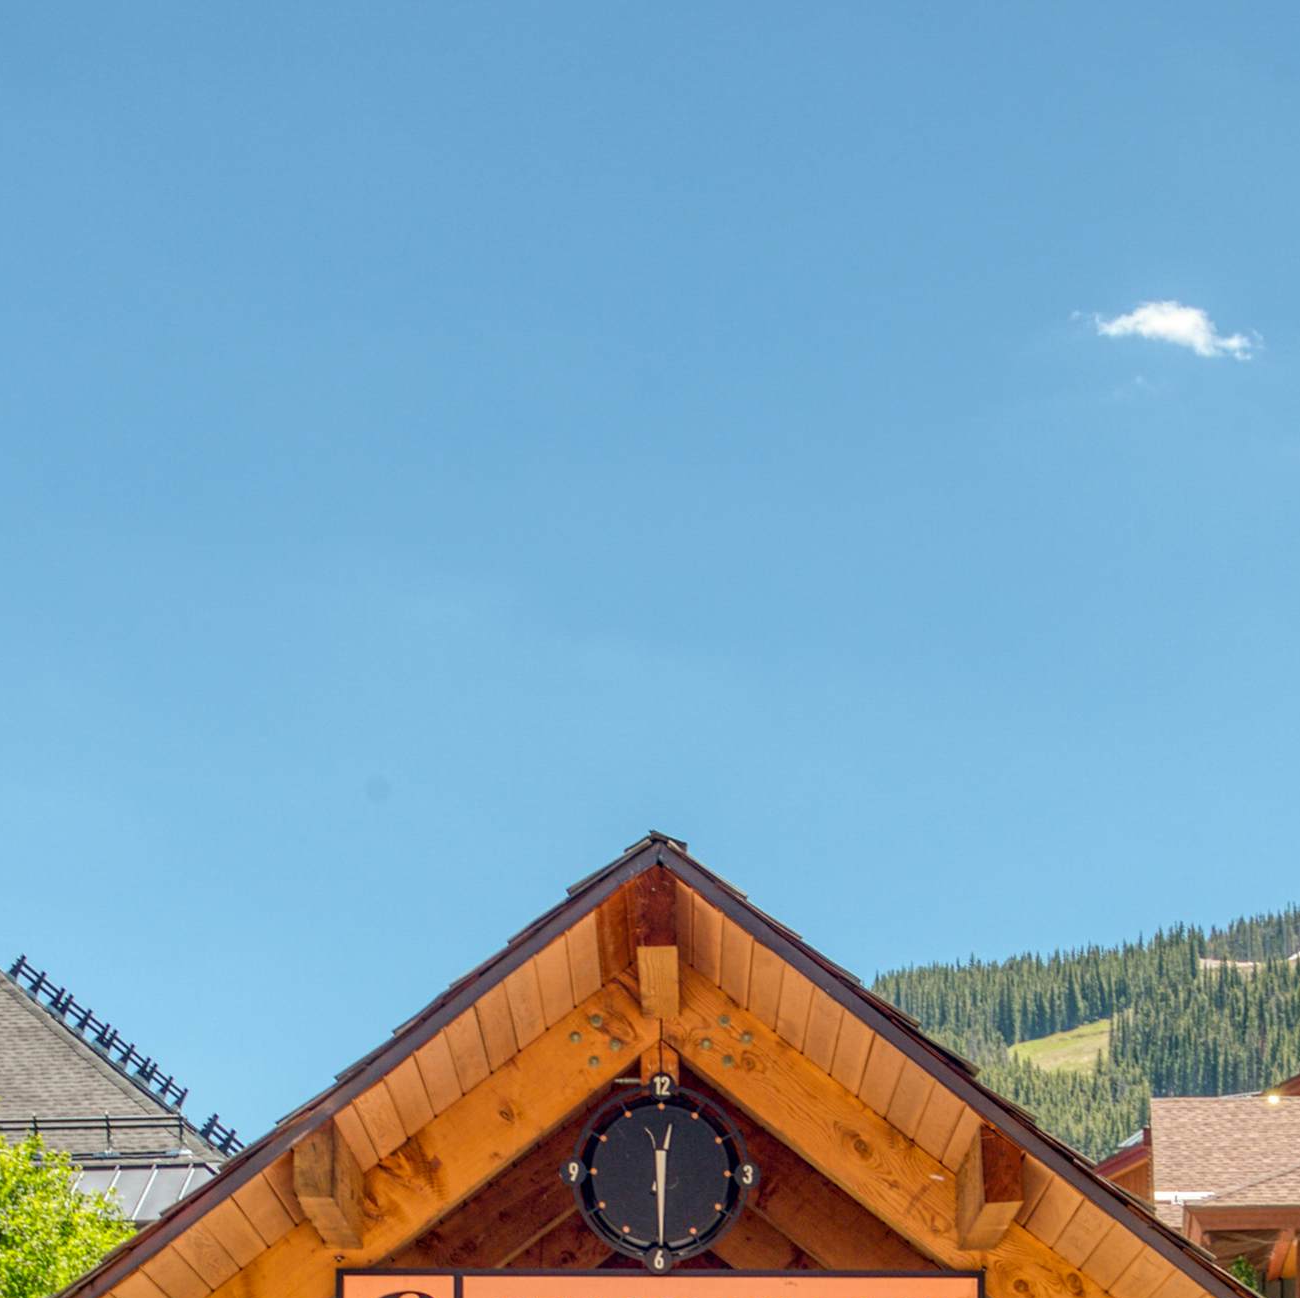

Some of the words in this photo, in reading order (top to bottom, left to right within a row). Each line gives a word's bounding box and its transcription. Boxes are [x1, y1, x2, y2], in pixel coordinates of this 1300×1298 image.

[653, 1075, 671, 1096] 12
[568, 1161, 579, 1182] 9
[742, 1164, 753, 1185] 3
[654, 1249, 664, 1270] 6
